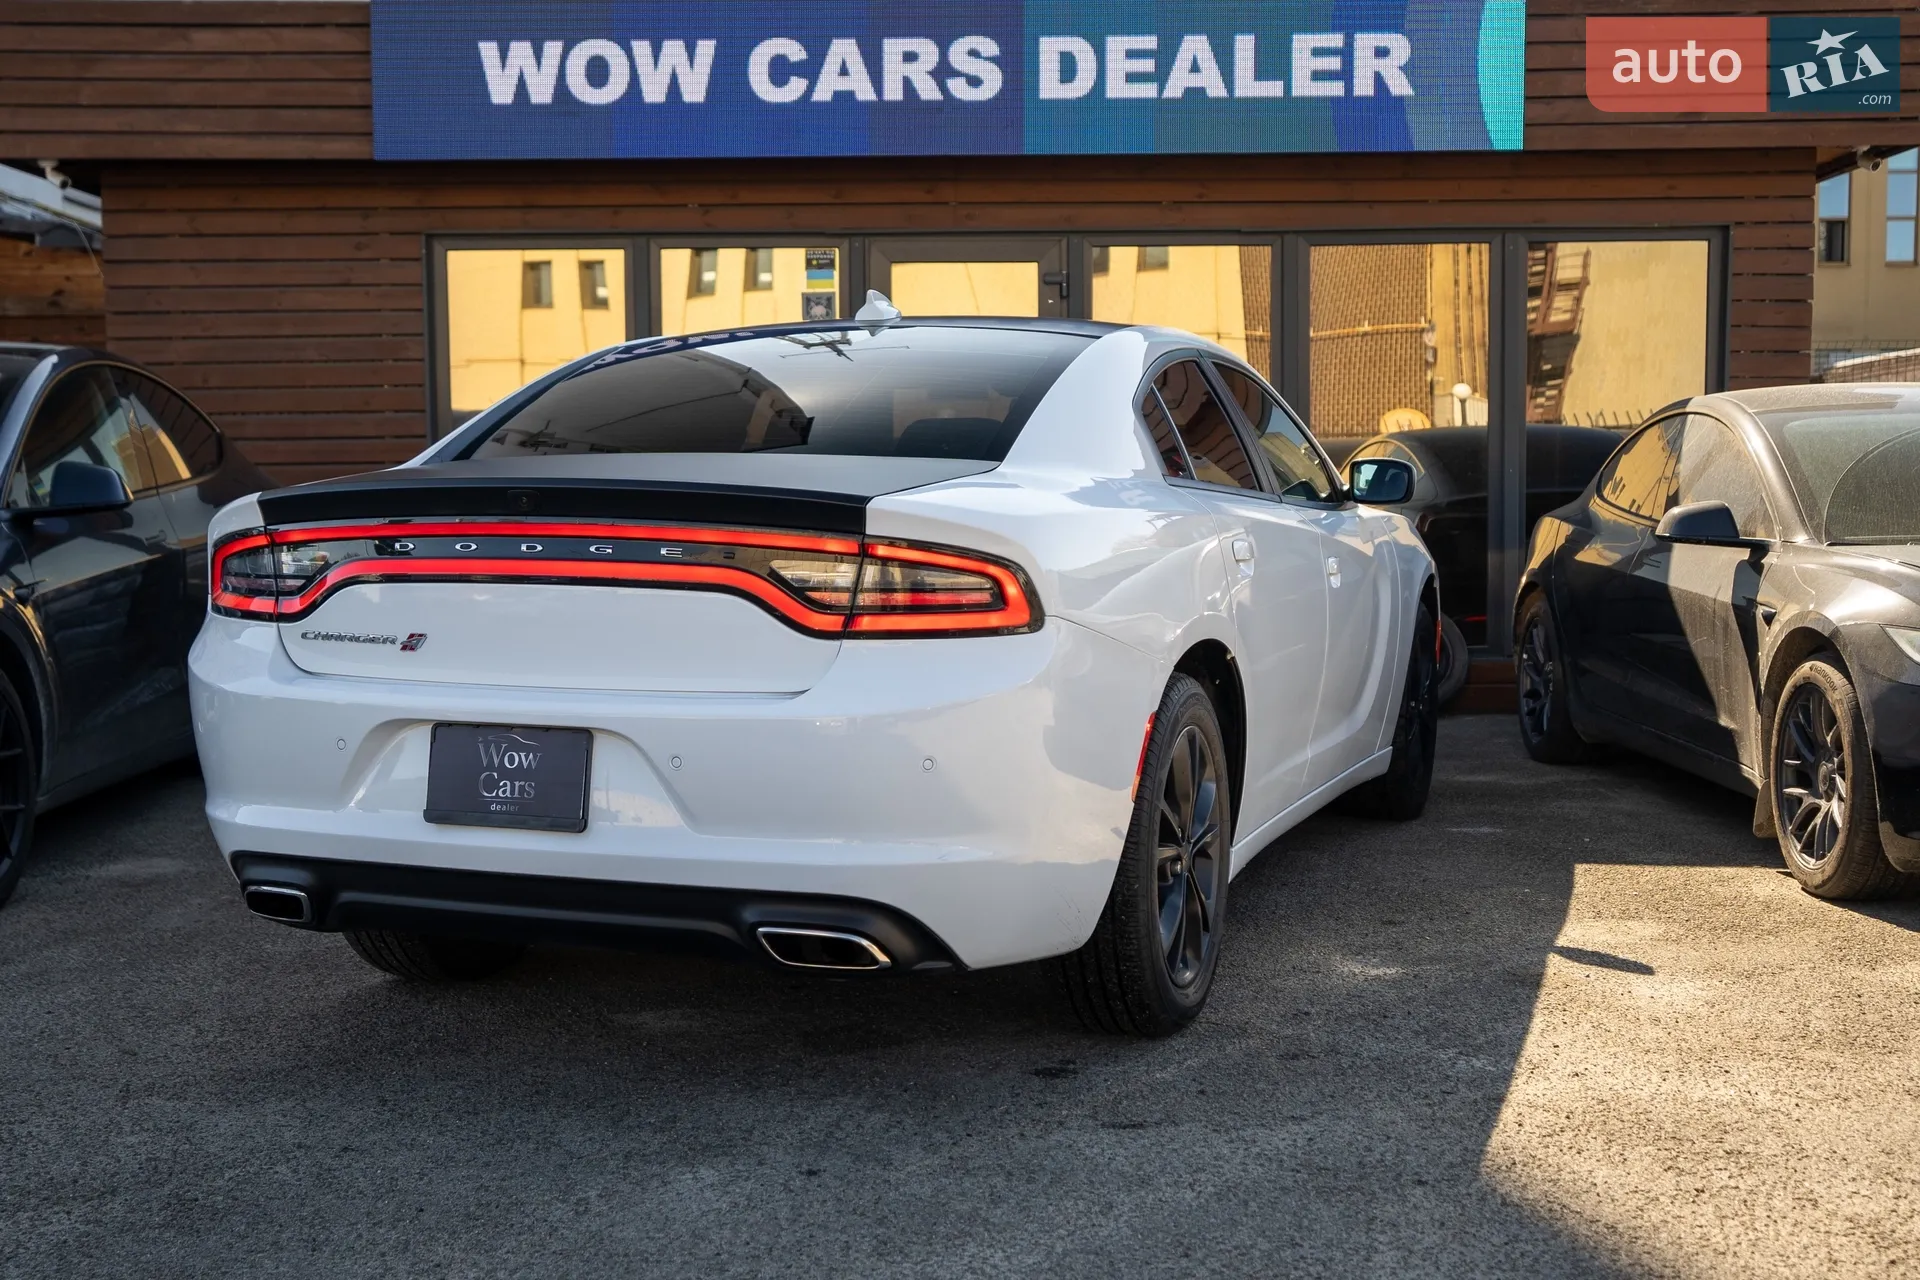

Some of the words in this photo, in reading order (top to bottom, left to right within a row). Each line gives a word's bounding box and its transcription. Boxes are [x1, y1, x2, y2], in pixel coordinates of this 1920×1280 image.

[478, 38, 717, 105] WOW
[748, 36, 1003, 103] CARS
[1038, 33, 1415, 100] DEALER
[394, 542, 683, 558] DODGE
[301, 630, 398, 645] CHARGER
[477, 742, 543, 770] Wow
[478, 771, 536, 798] Cars
[490, 802, 519, 812] dealer
